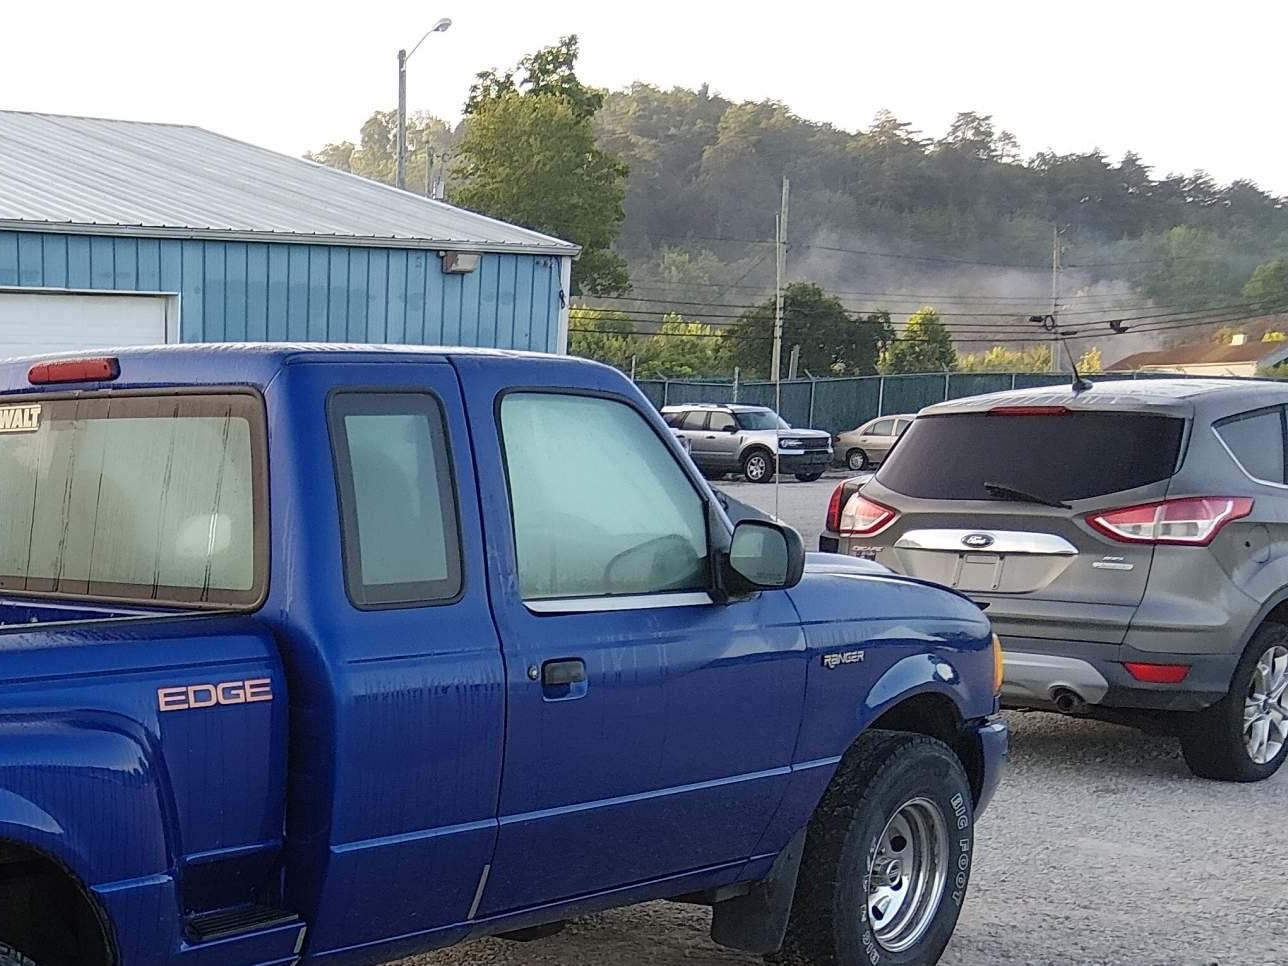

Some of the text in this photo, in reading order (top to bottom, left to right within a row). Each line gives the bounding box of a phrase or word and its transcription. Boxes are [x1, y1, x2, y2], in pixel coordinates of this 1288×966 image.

[824, 650, 865, 669] RANGER
[157, 678, 273, 712] EDGE
[951, 793, 970, 907] BIG FOOT
